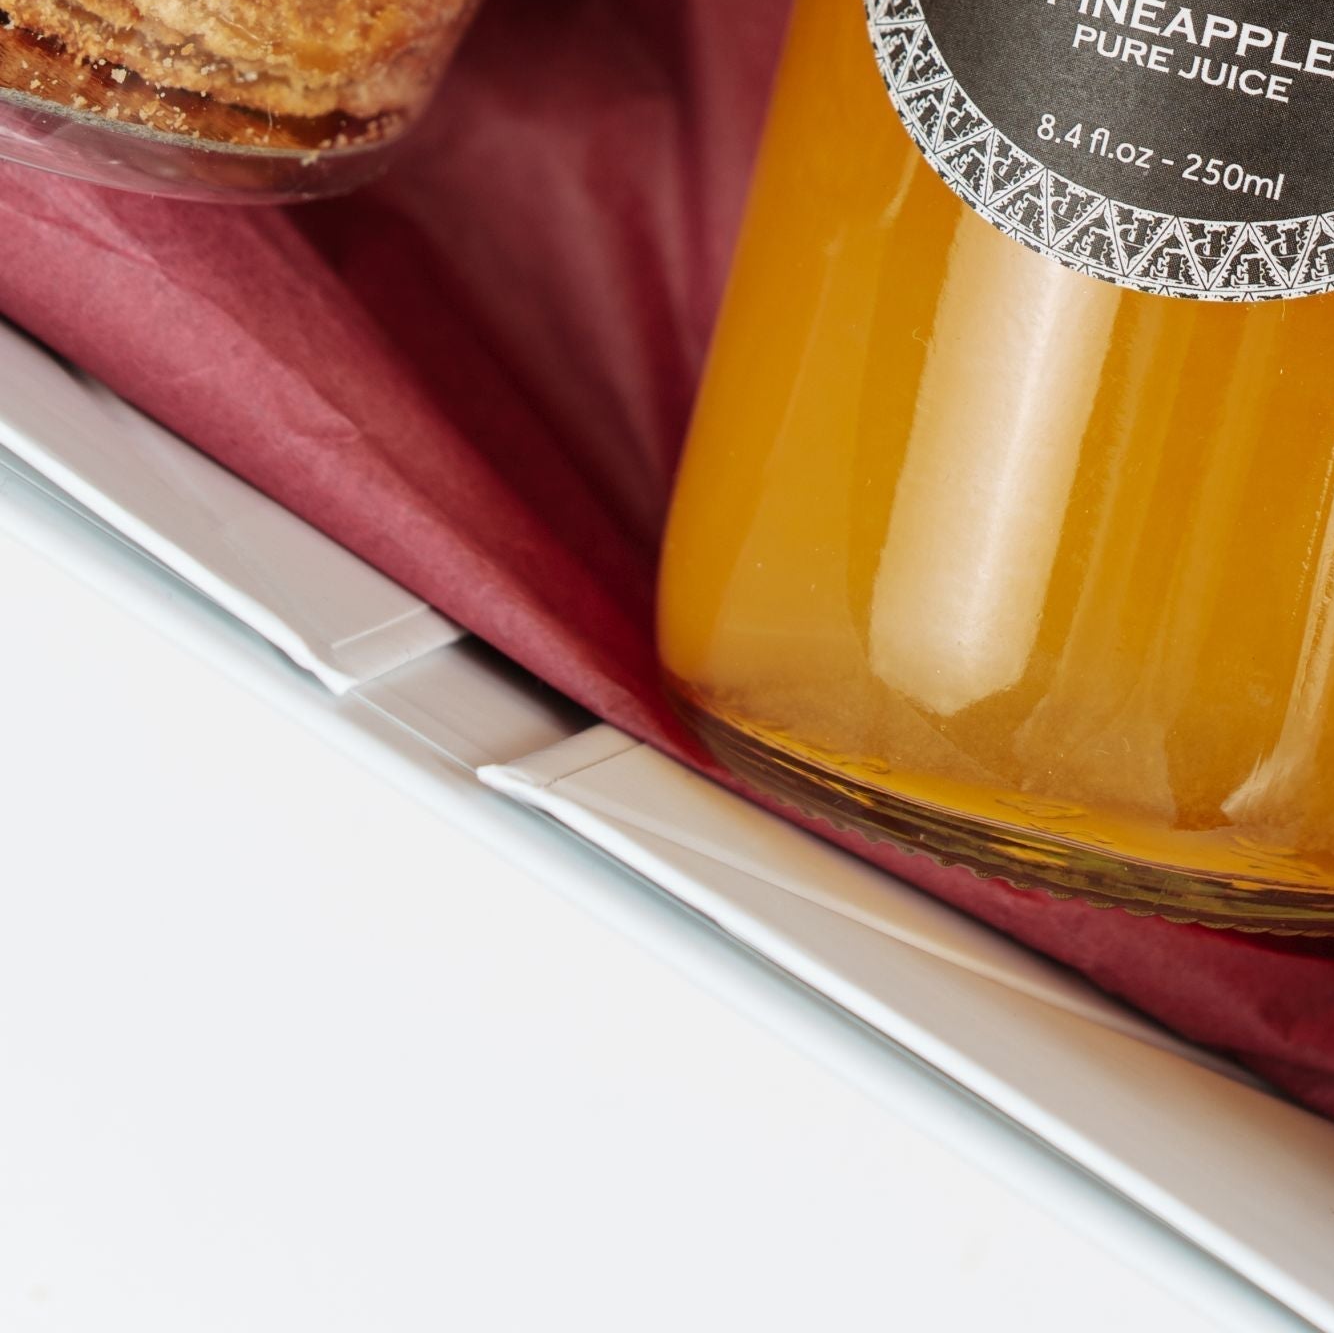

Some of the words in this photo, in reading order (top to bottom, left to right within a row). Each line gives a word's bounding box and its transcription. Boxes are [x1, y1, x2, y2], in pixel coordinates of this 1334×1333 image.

[1071, 24, 1175, 73] PURE
[1178, 54, 1294, 103] JUICE
[1036, 113, 1082, 151] 8.4
[1088, 126, 1152, 170] fl.oz
[1182, 153, 1285, 201] 250ml
